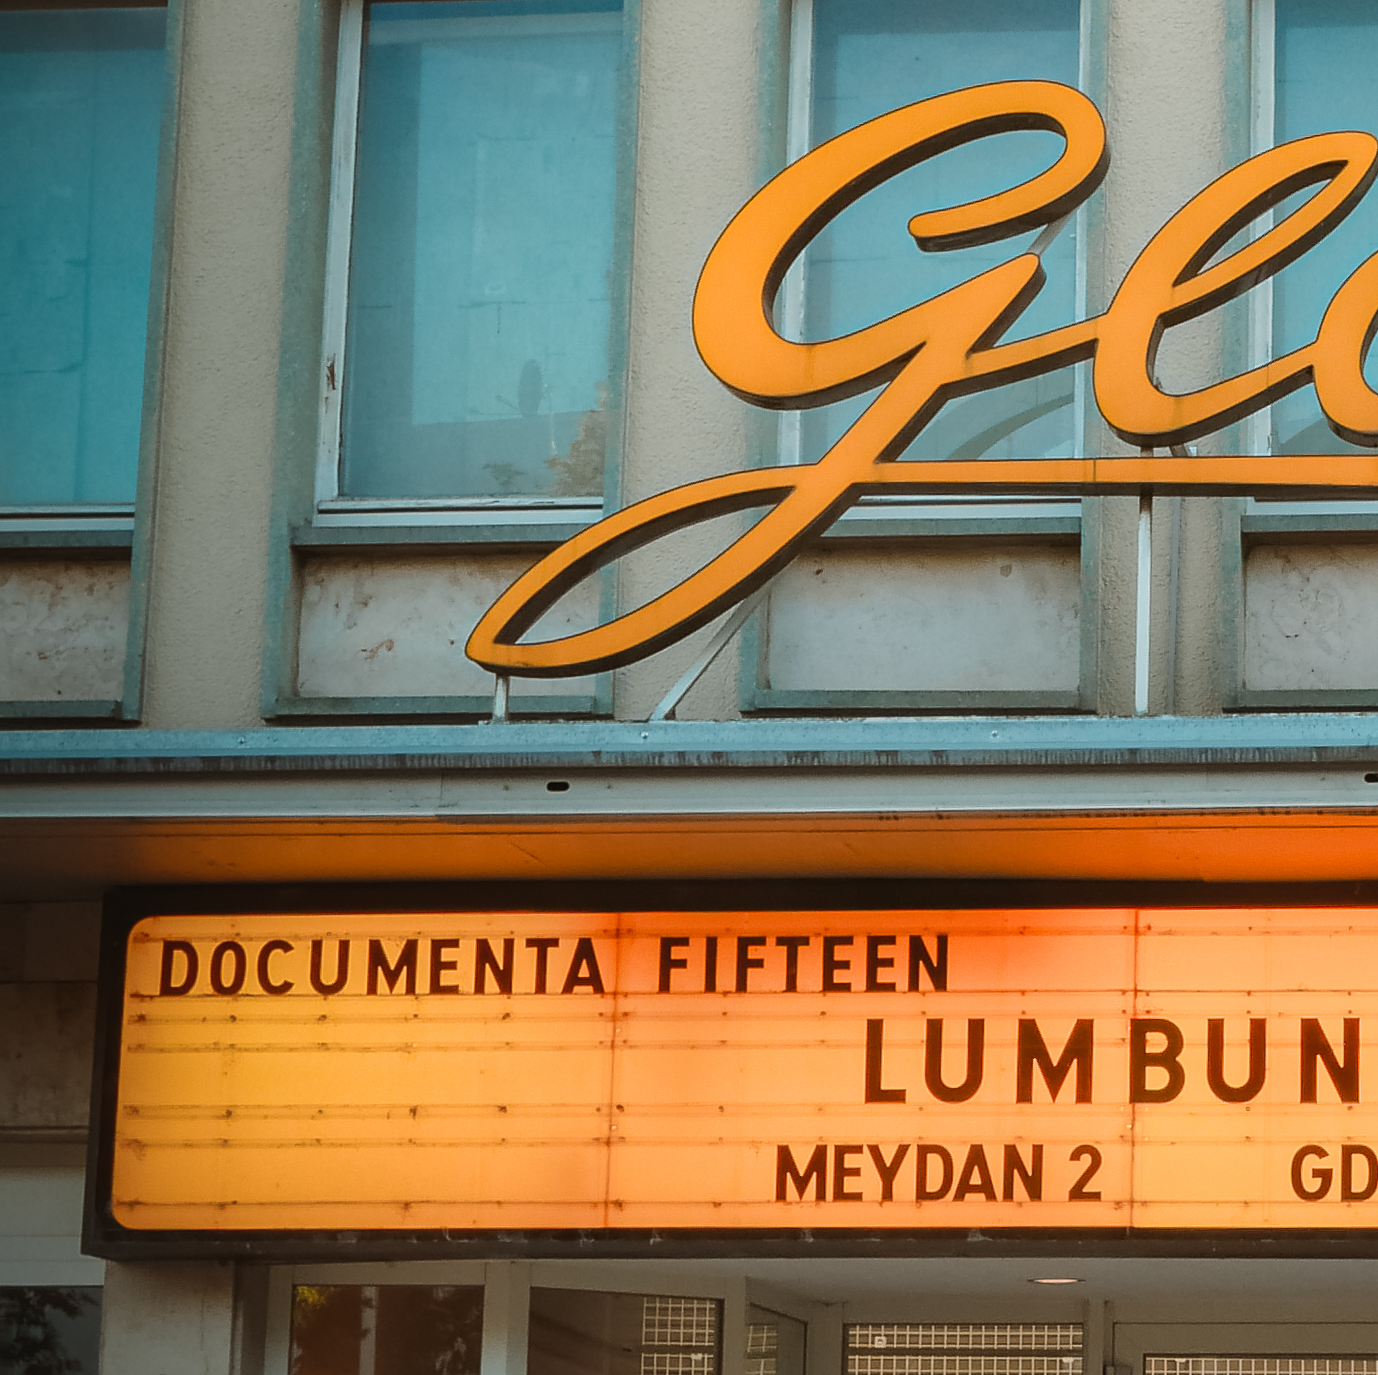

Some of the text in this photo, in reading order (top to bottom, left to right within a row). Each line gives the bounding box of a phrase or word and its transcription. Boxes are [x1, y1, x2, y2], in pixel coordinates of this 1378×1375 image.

[157, 934, 949, 997] DOCUMENTA FIFTEEN
[775, 1143, 1104, 1202] MEYDAN 2
